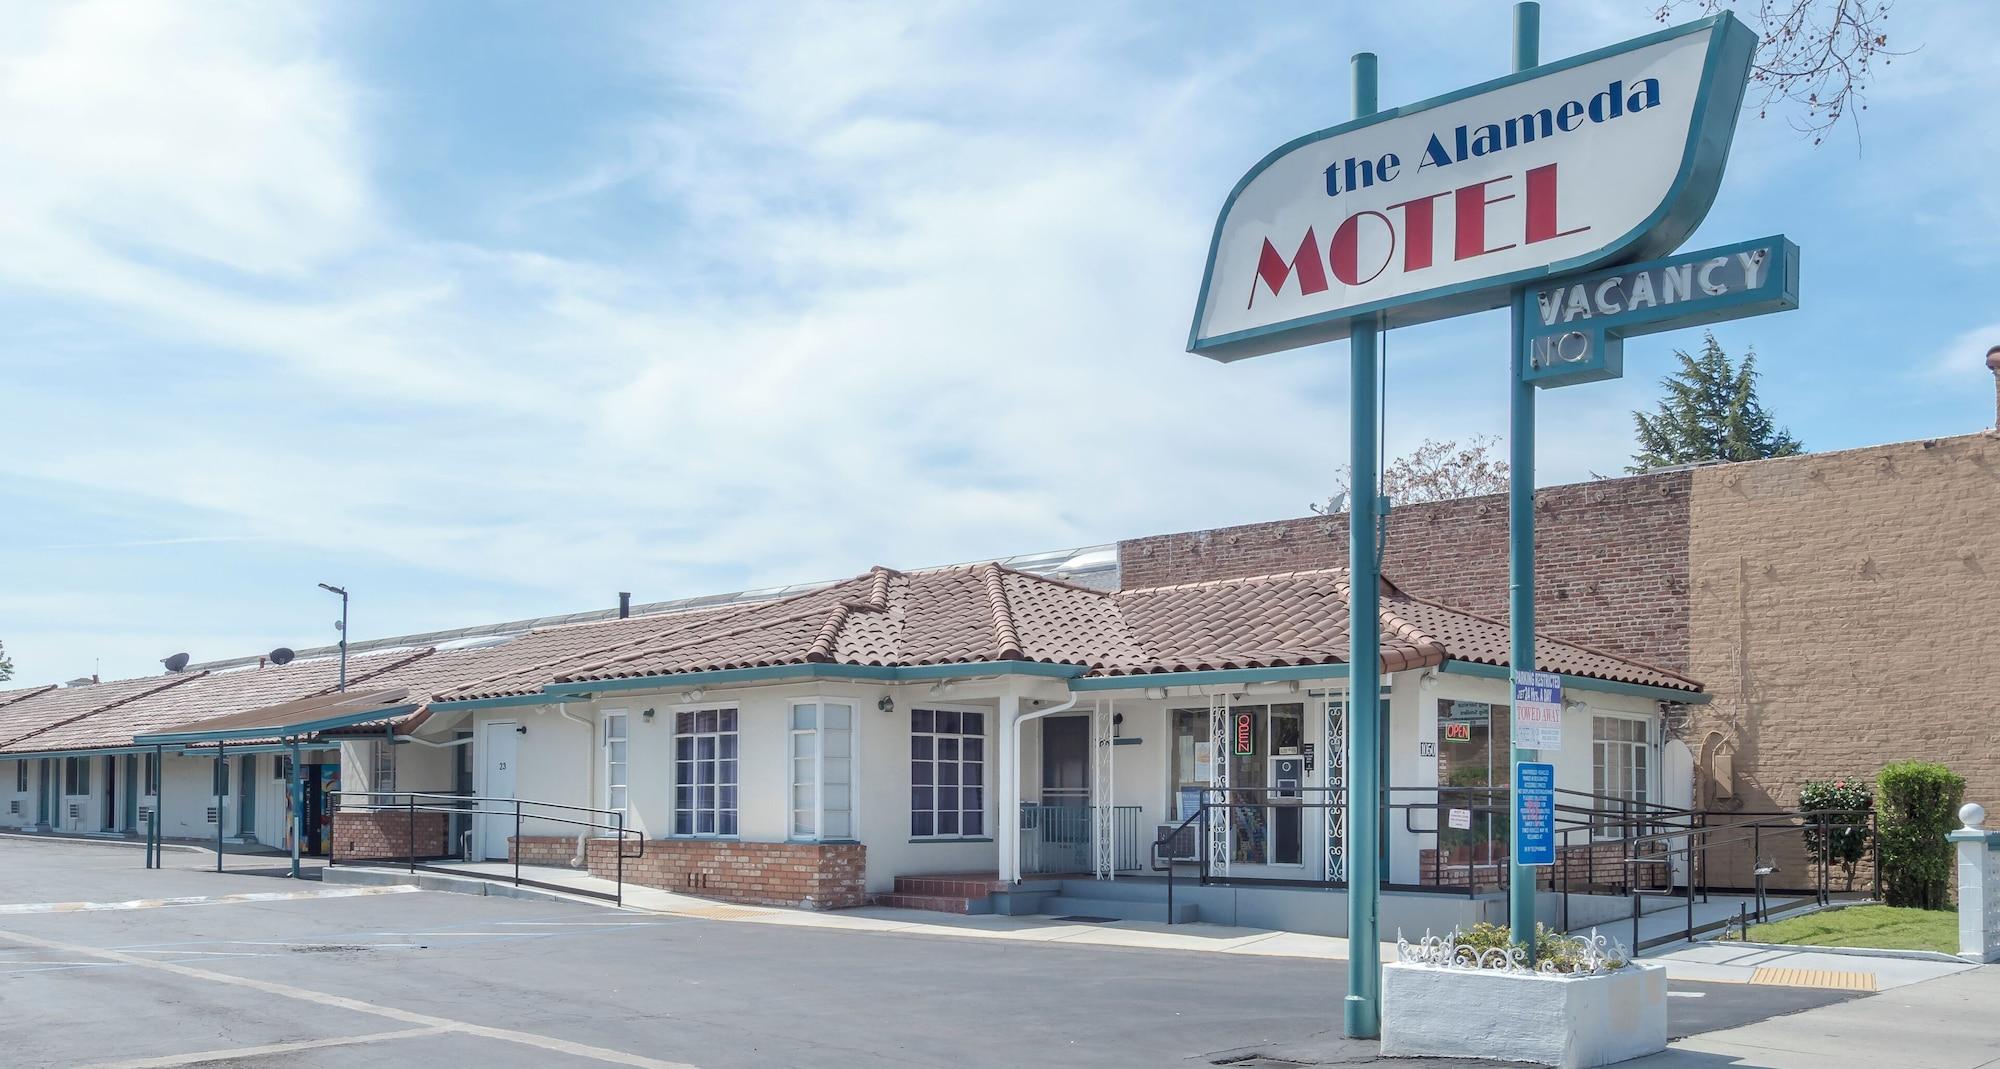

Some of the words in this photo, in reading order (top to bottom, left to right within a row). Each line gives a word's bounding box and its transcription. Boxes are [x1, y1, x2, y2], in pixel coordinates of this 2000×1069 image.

[1324, 152, 1401, 198] the
[1417, 77, 1661, 175] Alameda
[1247, 162, 1592, 311] MOTEL
[1537, 248, 1769, 326] VACANCY
[1529, 331, 1588, 368] NO
[1516, 671, 1534, 686] PARKING
[1535, 673, 1560, 688] RESTRICTED
[1238, 714, 1250, 752] OPEN
[1447, 723, 1469, 738] OPEN
[1517, 706, 1541, 721] TOWED
[1543, 708, 1560, 723] AWAY
